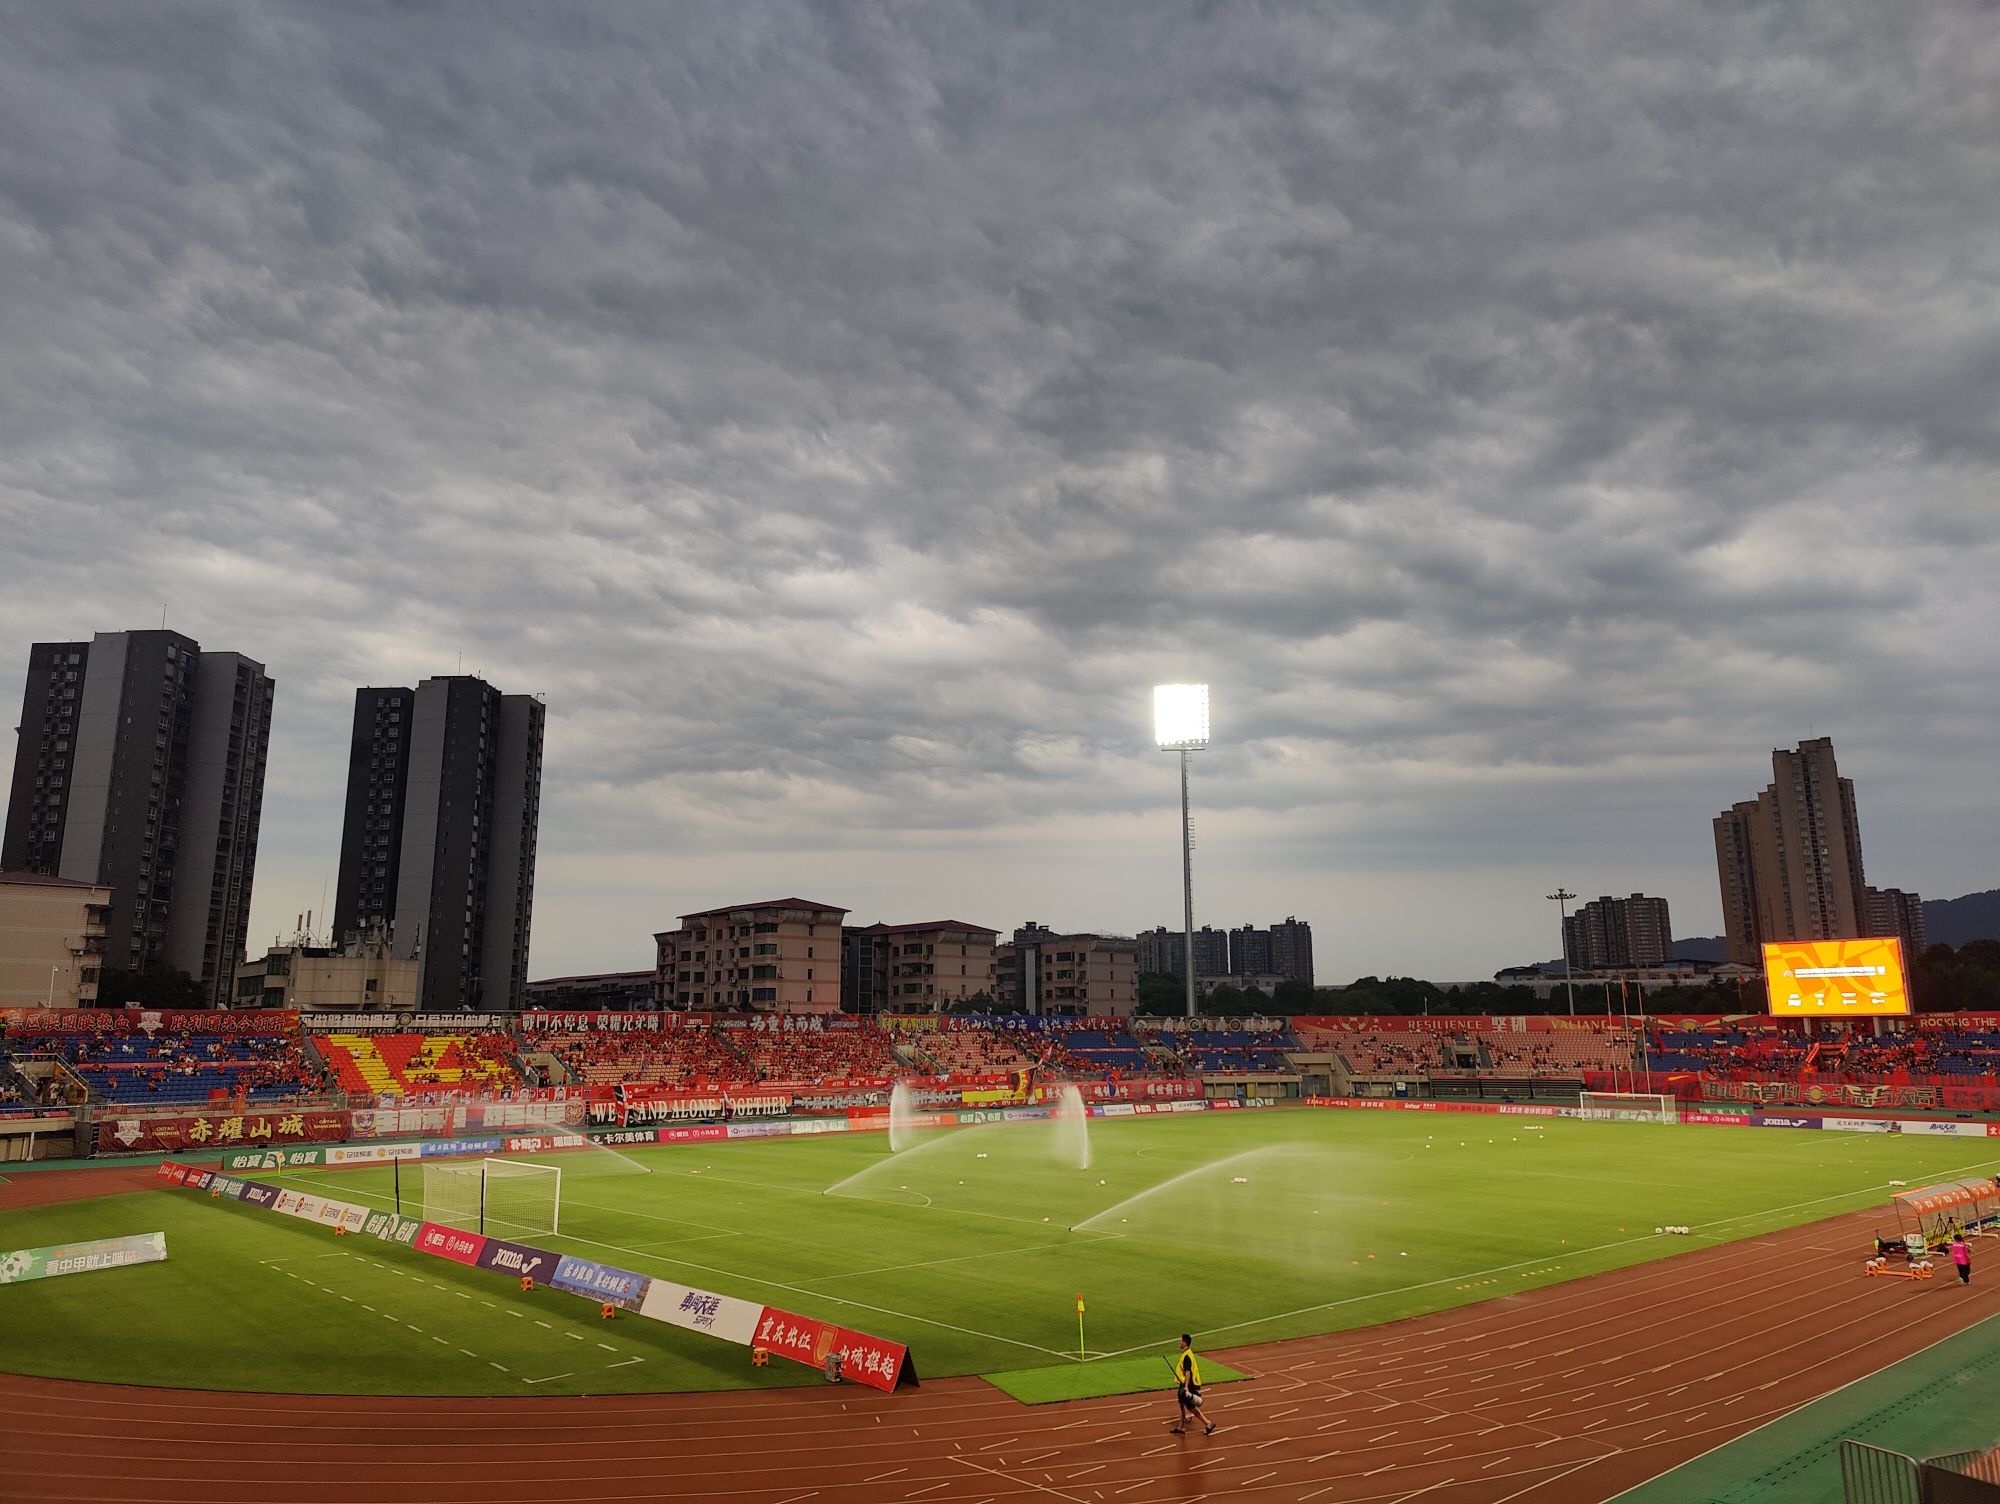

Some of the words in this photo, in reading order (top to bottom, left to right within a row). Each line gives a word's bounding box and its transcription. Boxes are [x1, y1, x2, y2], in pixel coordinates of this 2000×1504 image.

[1408, 1019, 1483, 1030] RESILIENCE
[1491, 1016, 1527, 1033] 坚韧
[1973, 1016, 1998, 1027] THE
[594, 1102, 616, 1123] WE
[671, 1098, 716, 1119] ALONE
[189, 1115, 305, 1141] 赤耀山城
[604, 1131, 654, 1144] 卡尔美体育
[679, 1291, 722, 1316] 勇闯天涯
[757, 1316, 812, 1351] 重庆出征
